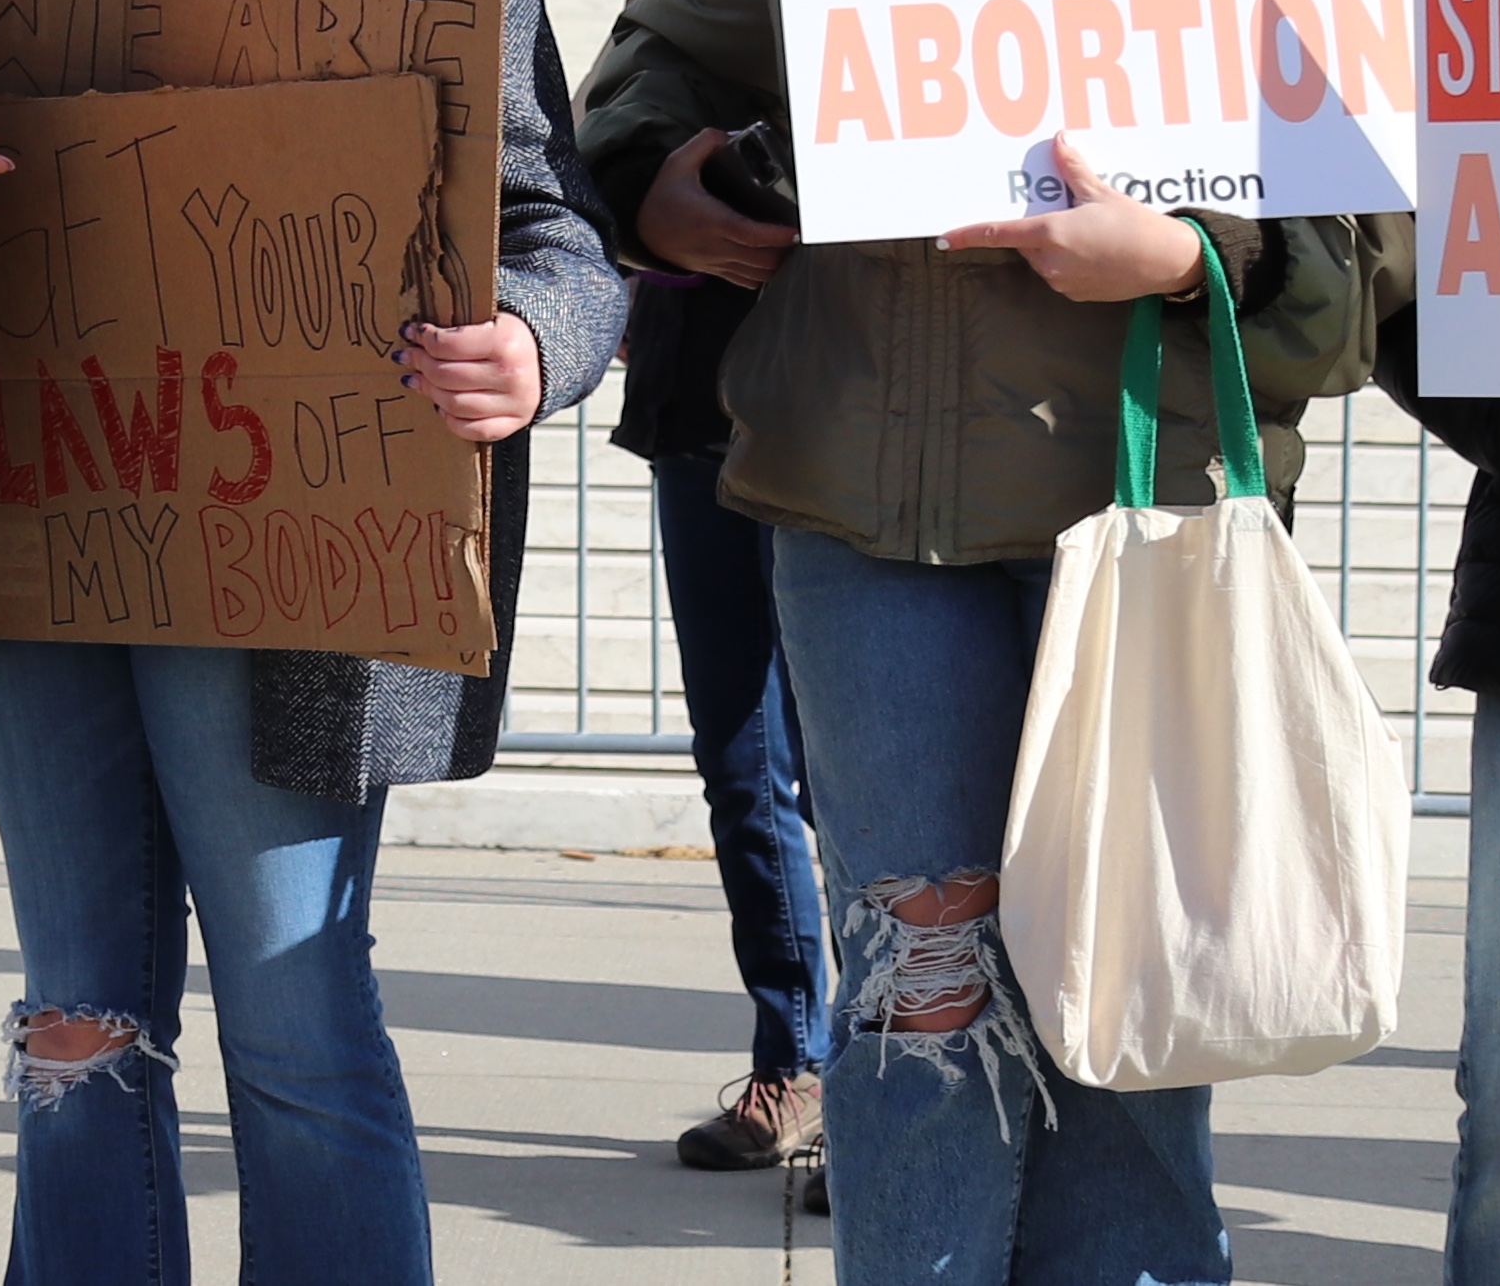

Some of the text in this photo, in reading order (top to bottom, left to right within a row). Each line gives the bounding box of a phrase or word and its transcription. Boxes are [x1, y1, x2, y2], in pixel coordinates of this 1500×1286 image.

[1007, 168, 1265, 206] Reoaction
[181, 184, 394, 358] YOUR
[294, 391, 415, 489] OFF
[44, 503, 458, 638] MY BODY!
